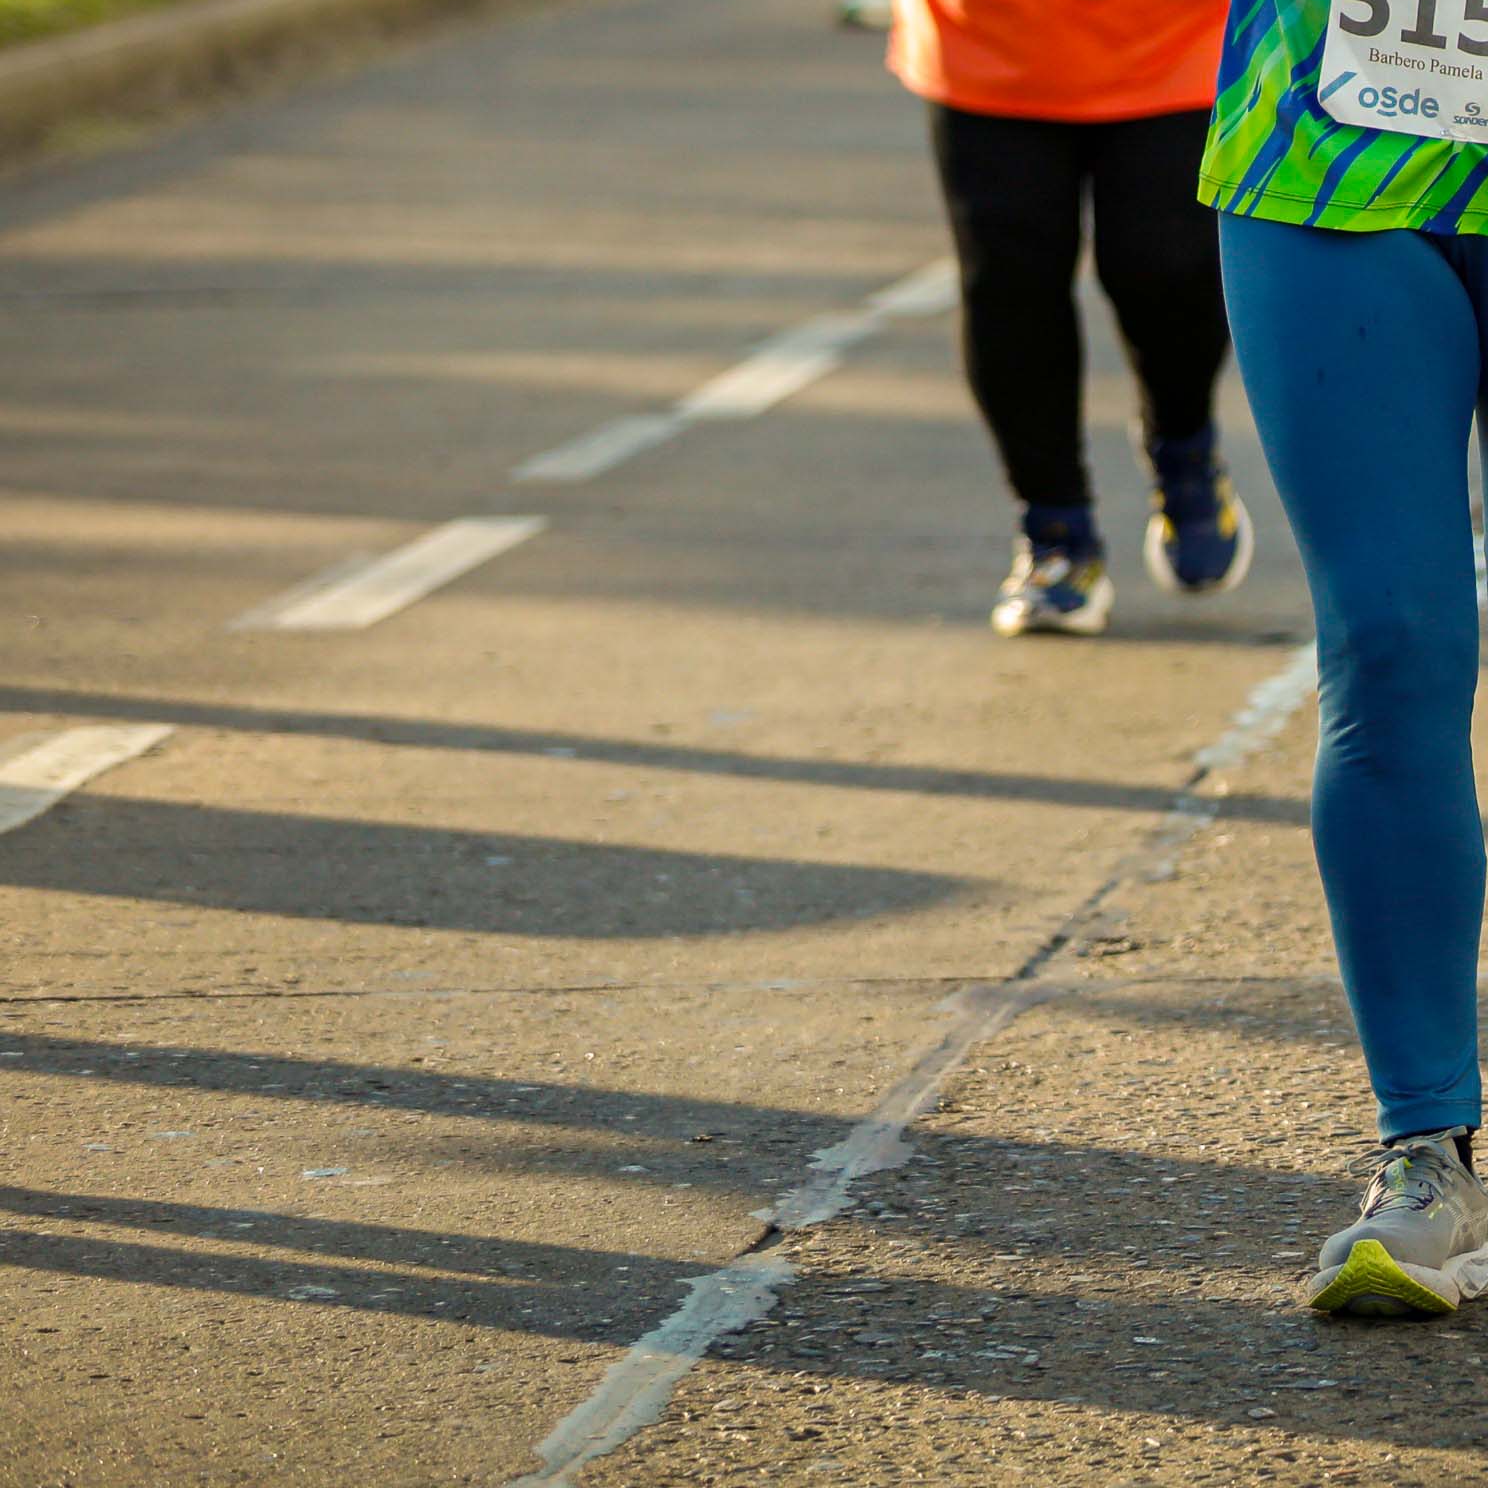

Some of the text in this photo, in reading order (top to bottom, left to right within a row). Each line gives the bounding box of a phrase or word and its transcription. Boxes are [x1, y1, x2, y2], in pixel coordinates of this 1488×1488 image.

[1368, 47, 1426, 70] Barbero
[1430, 59, 1483, 80] Pamela
[1358, 86, 1440, 119] osde
